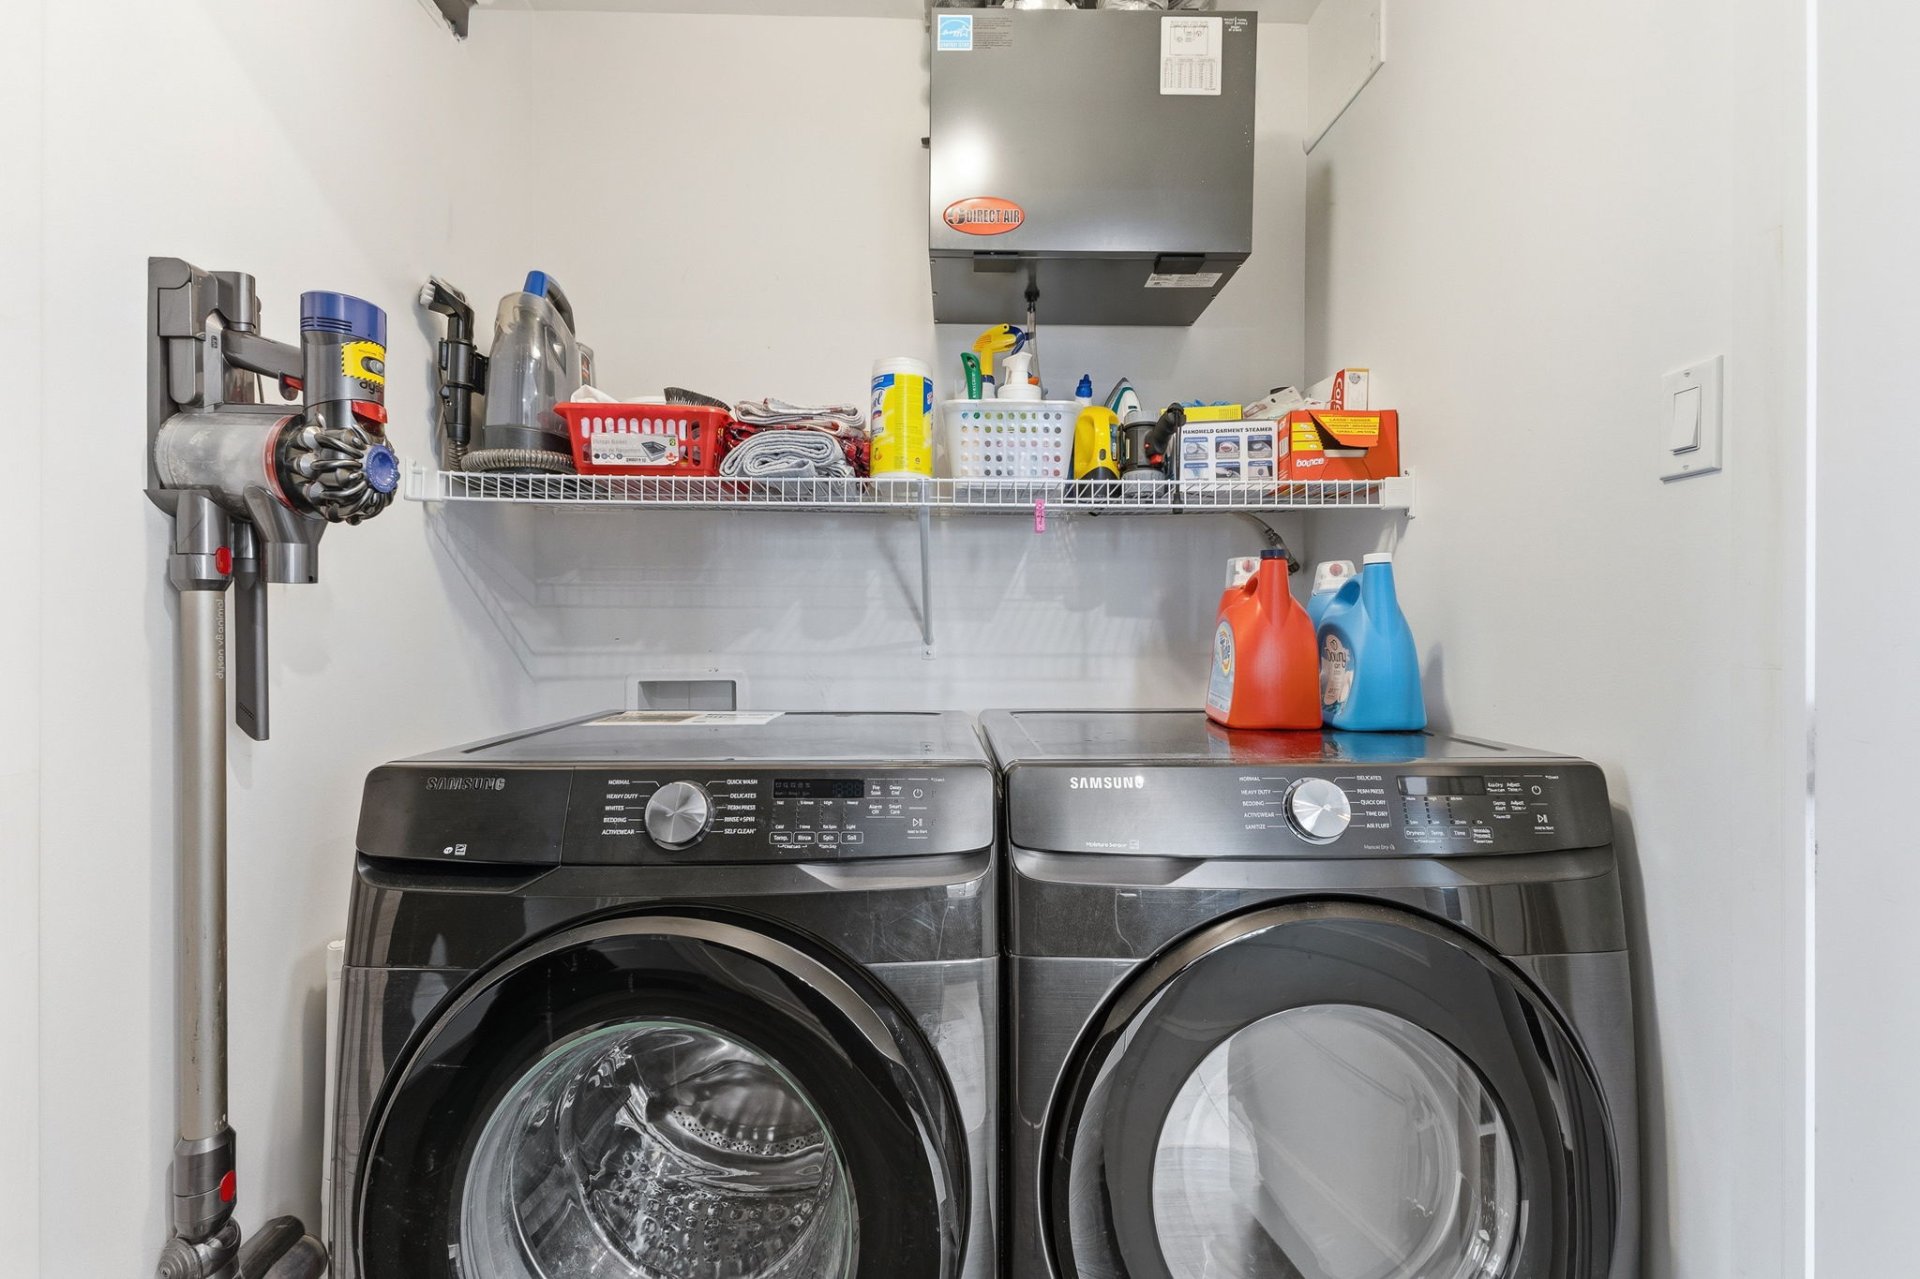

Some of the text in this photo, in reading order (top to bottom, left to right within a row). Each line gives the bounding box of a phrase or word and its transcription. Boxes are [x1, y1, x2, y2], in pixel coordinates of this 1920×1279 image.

[966, 209, 1020, 223] DIRECT AIR
[1296, 457, 1324, 468] bounce
[216, 649, 224, 680] dyson
[426, 776, 506, 791] SAMSUNG
